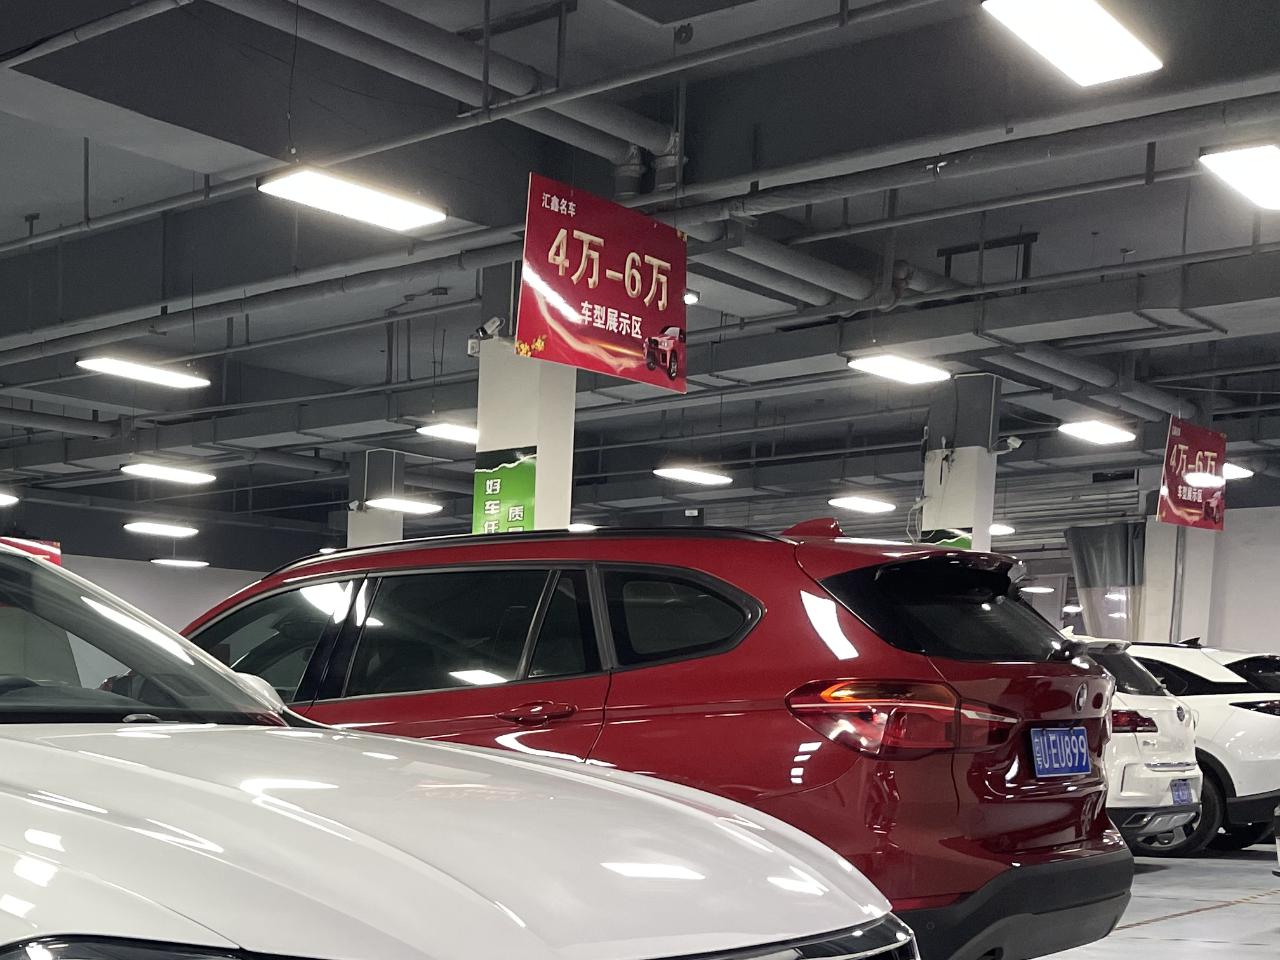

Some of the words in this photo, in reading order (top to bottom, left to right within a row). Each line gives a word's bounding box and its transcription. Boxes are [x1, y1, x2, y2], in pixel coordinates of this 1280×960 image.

[541, 192, 576, 217] 汇鑫名车
[548, 228, 672, 311] 4万-6万
[580, 300, 643, 339] 车型展示区
